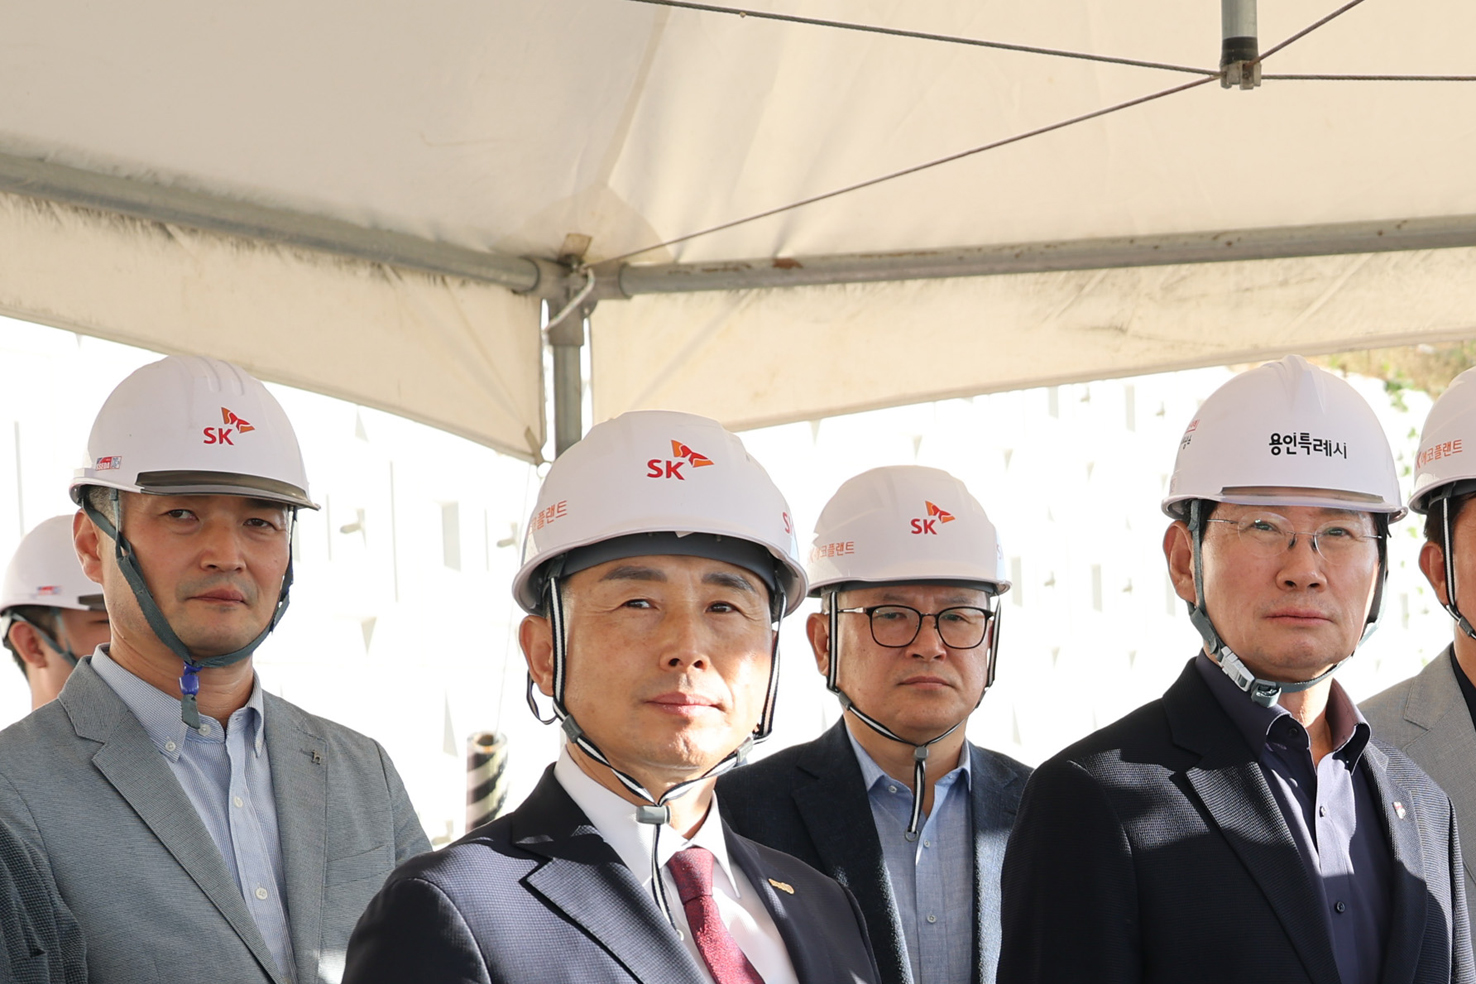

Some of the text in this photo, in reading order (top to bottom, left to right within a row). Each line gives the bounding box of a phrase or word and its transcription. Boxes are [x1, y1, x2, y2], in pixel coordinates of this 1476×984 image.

[203, 427, 234, 446] SK
[1268, 432, 1348, 459] 용인특례시
[647, 459, 685, 481] SK
[910, 518, 938, 535] SK
